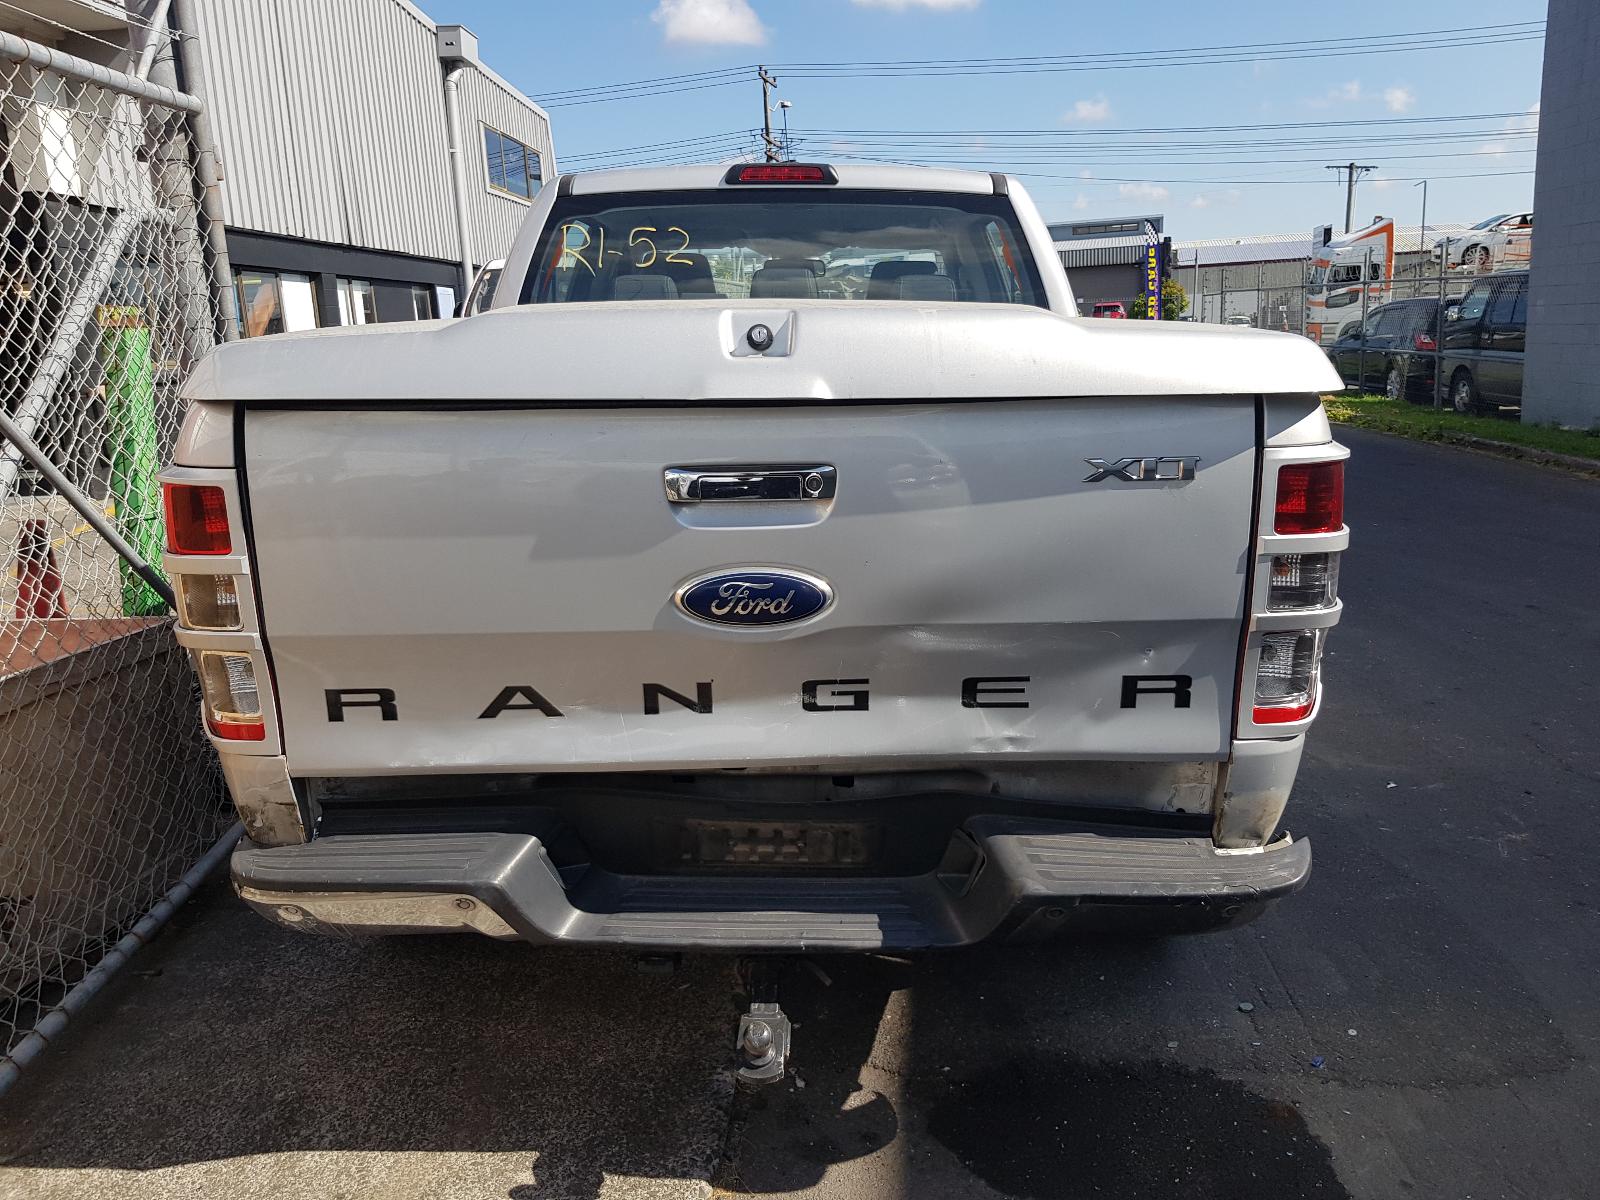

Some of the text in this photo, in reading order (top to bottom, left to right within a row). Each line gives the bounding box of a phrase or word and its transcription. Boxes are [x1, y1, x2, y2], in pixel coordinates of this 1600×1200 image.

[1082, 456, 1201, 483] XLT
[711, 581, 796, 616] Ford
[324, 675, 1192, 722] RANGER
